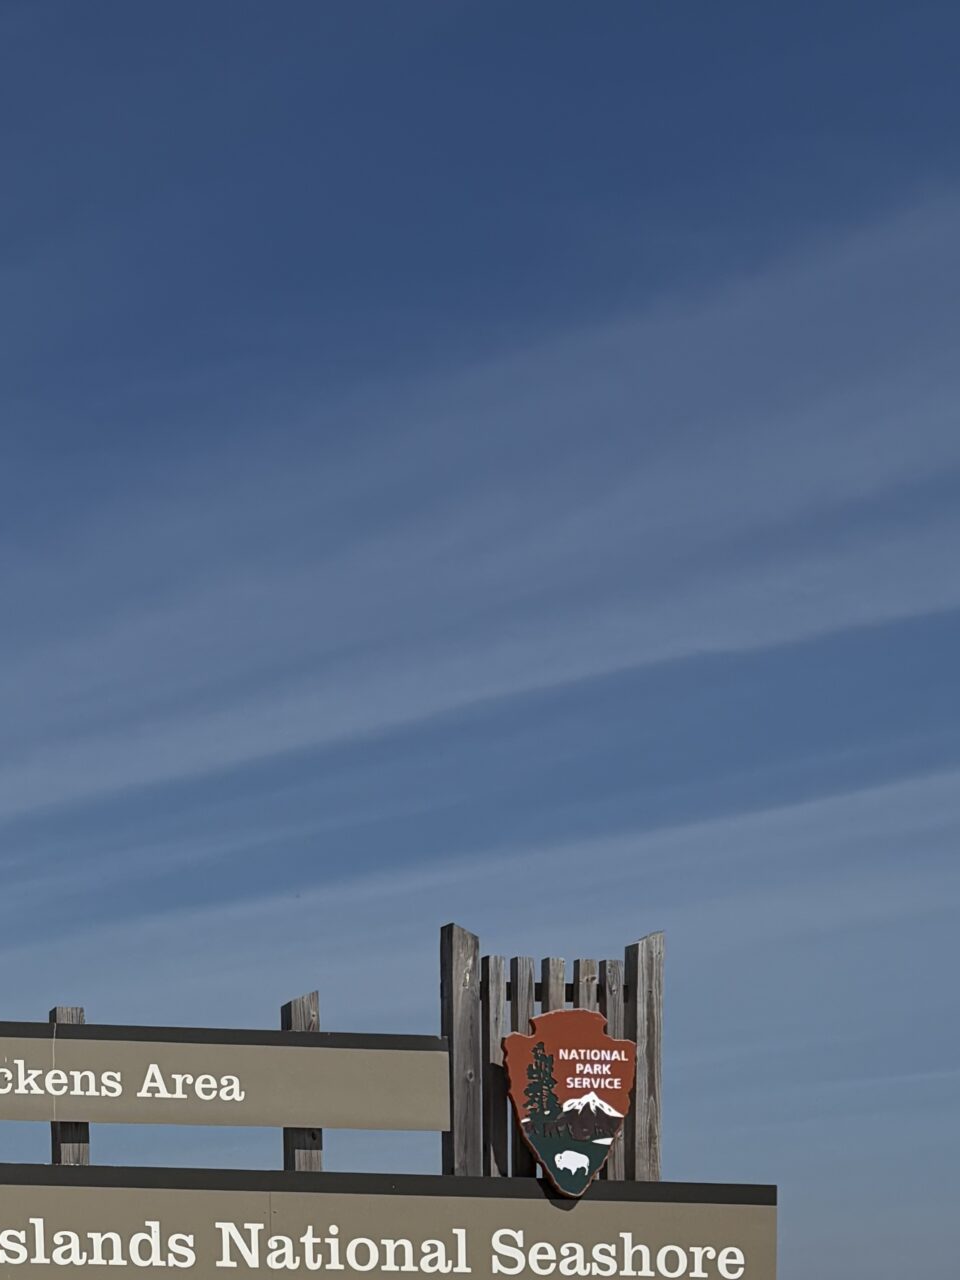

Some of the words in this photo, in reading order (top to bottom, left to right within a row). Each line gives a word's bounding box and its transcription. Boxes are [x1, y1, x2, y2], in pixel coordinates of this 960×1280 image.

[559, 1048, 629, 1062] NATIONAL
[575, 1063, 612, 1075] PARK
[136, 1063, 245, 1102] Area
[566, 1076, 622, 1089] SERVICE
[214, 1221, 472, 1274] National
[491, 1228, 745, 1280] Seashore
